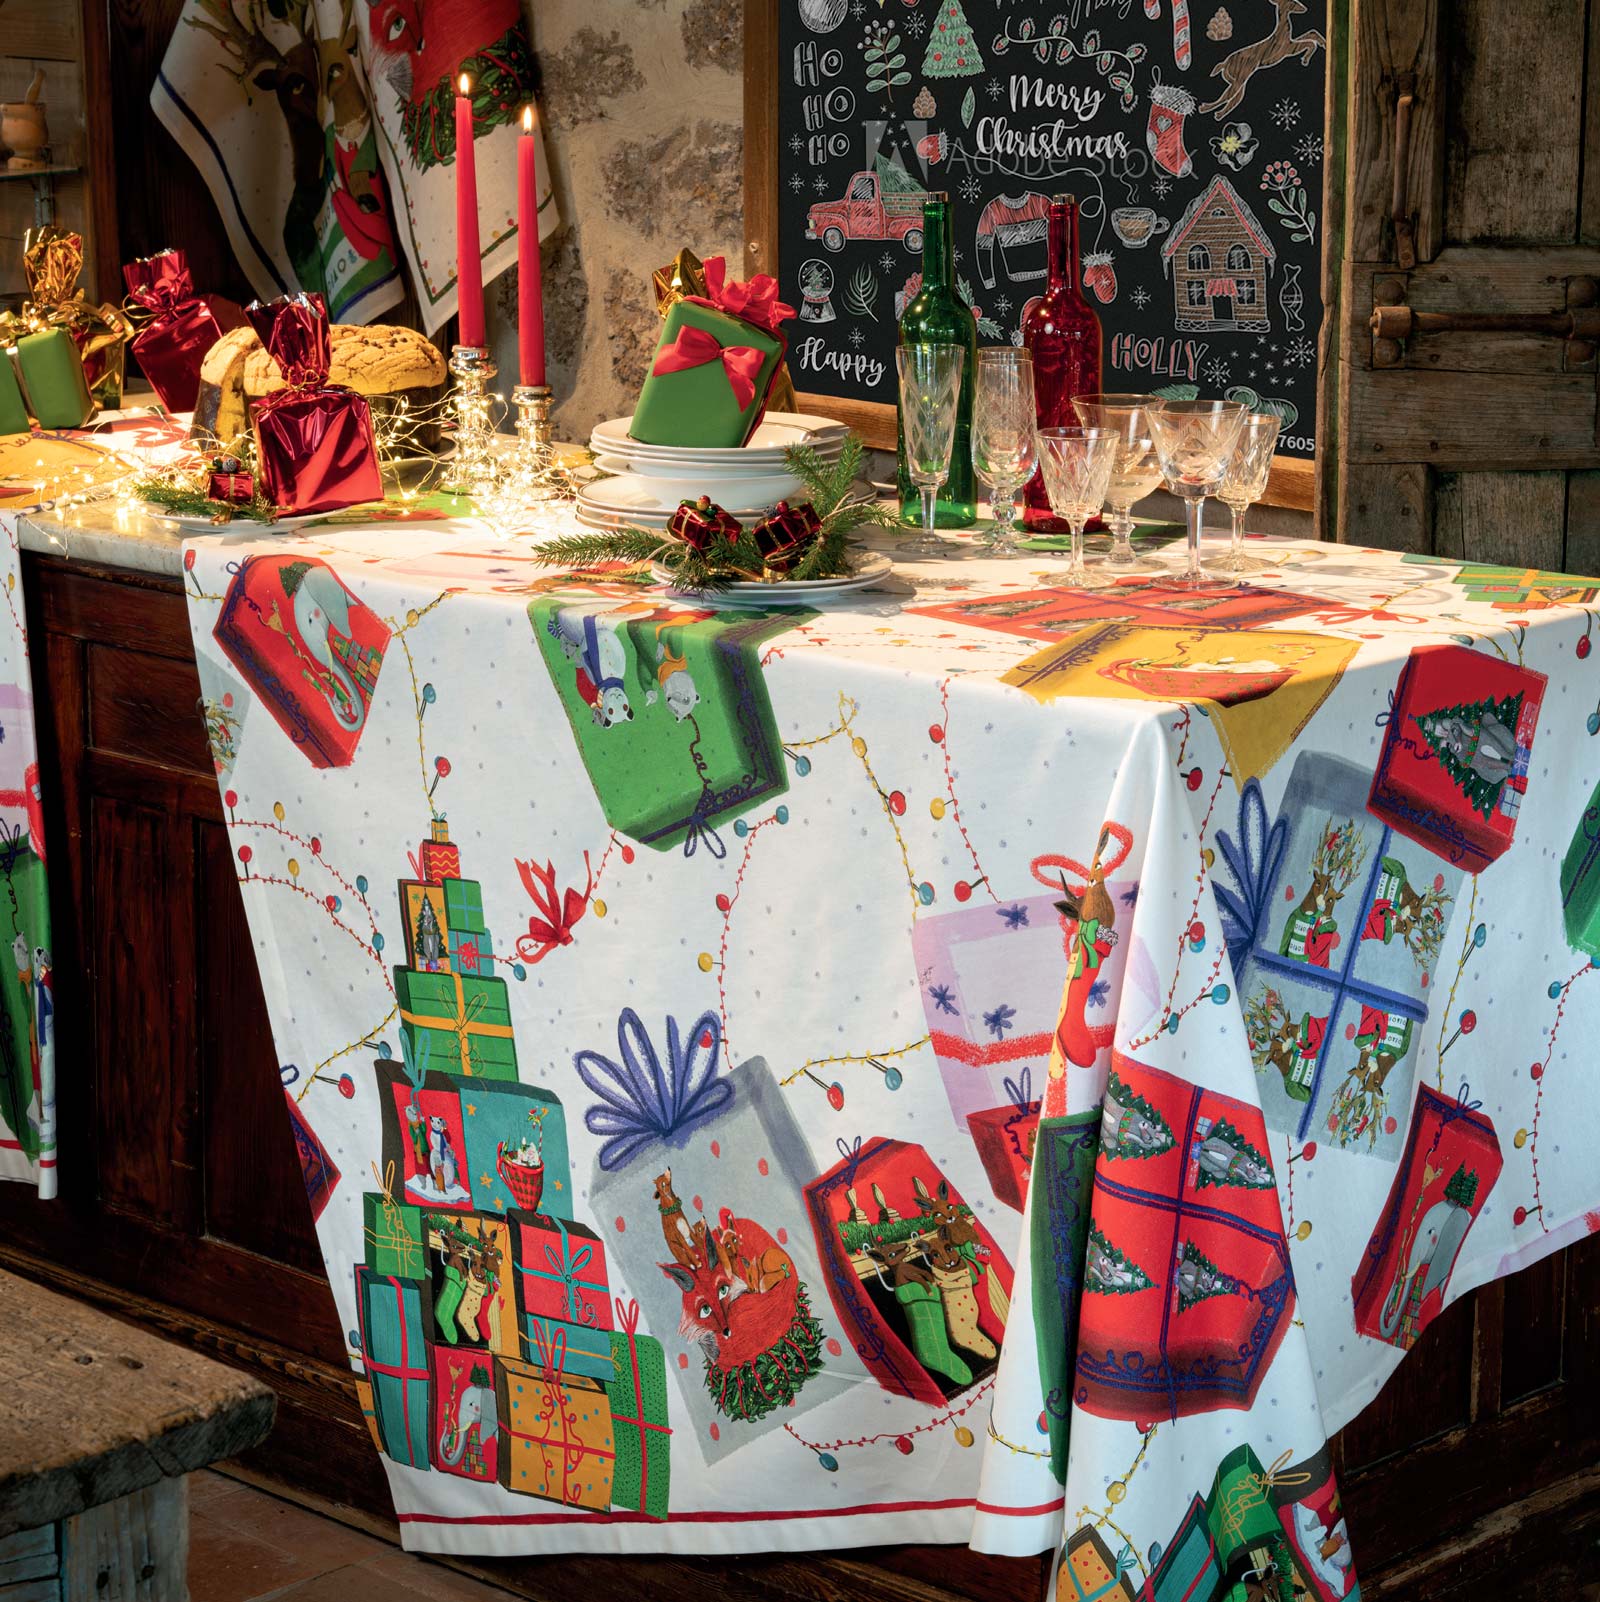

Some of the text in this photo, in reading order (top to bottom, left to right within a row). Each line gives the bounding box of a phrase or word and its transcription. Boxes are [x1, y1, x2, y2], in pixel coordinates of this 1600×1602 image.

[793, 41, 844, 87] HO
[802, 86, 856, 131] HO
[1009, 74, 1106, 122] Merry
[808, 132, 850, 166] HO
[946, 134, 1199, 180] Adobe Stock
[976, 116, 1130, 160] Christmas
[795, 336, 887, 387] Happy
[1112, 333, 1209, 381] HOLLY
[1276, 434, 1315, 452] 7605
